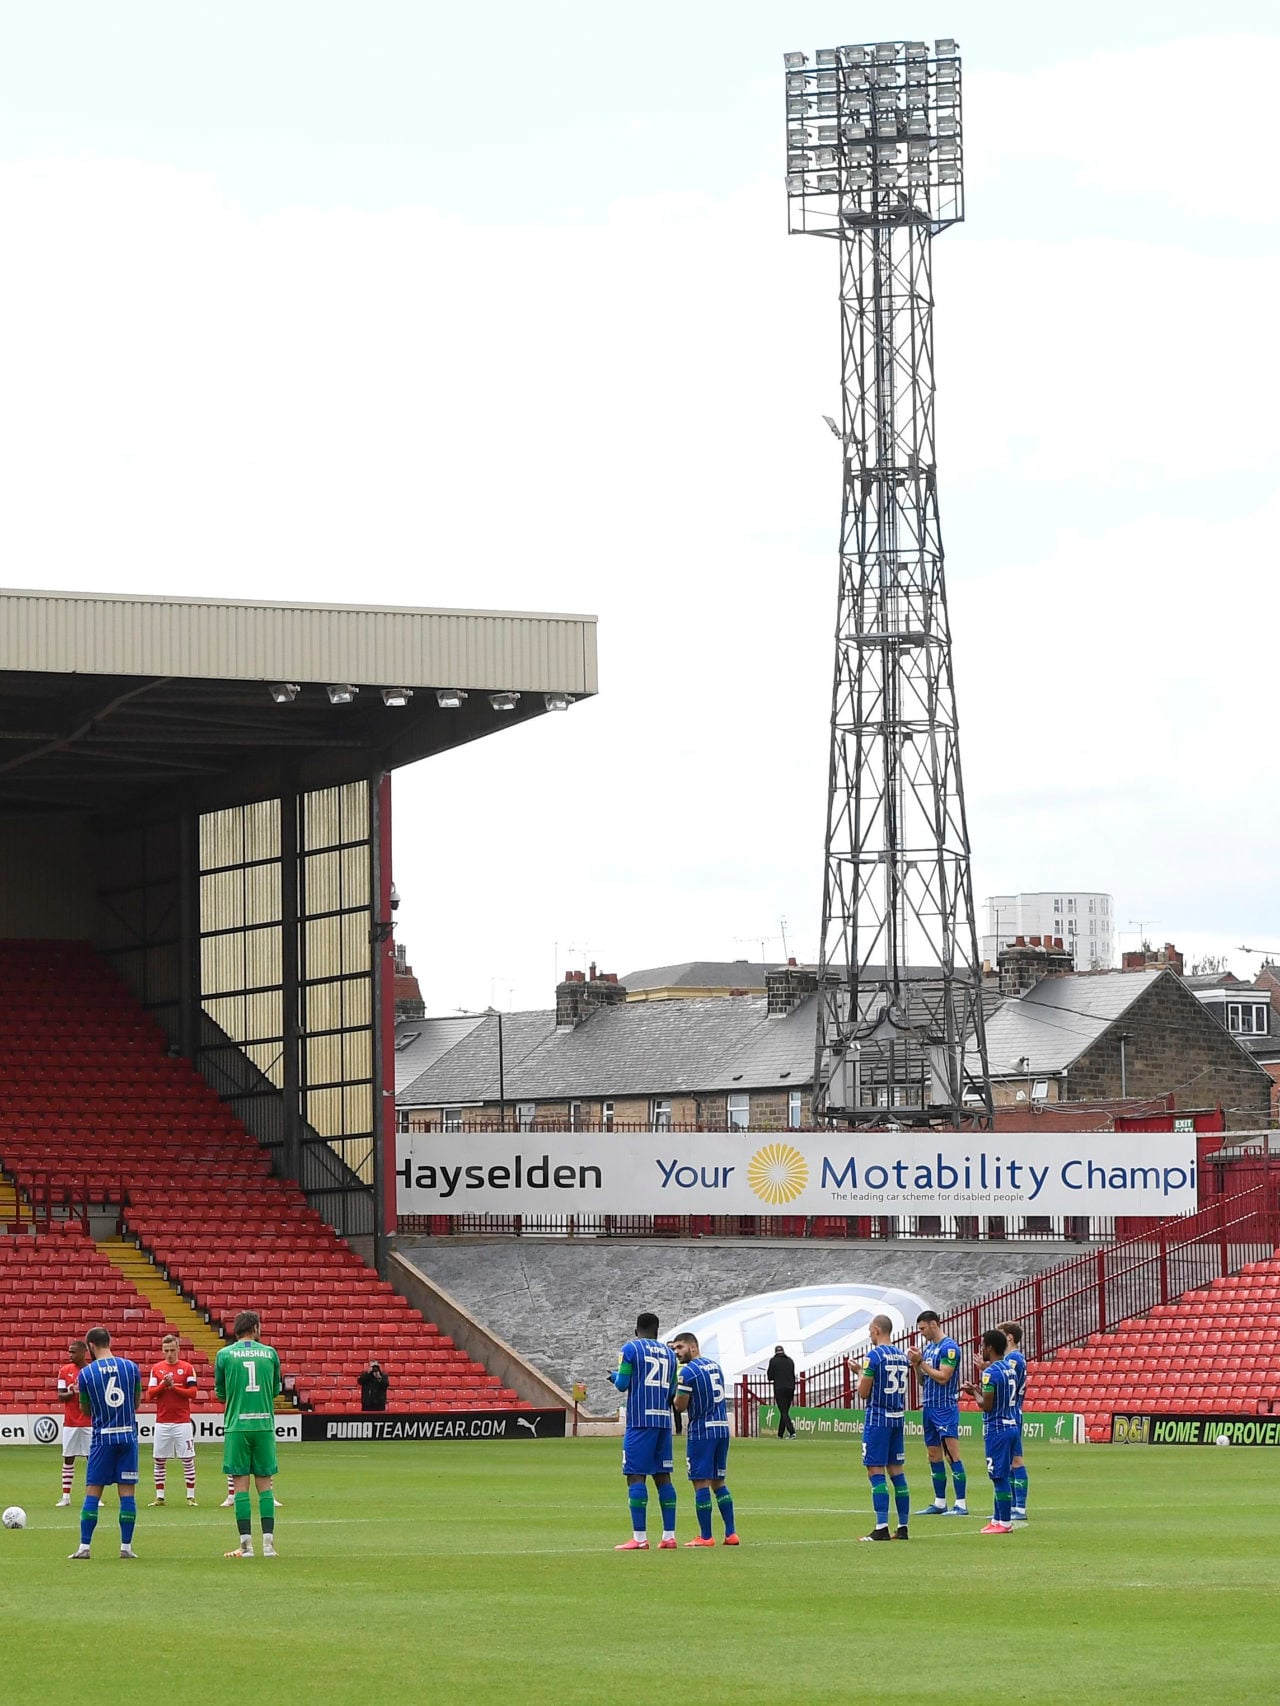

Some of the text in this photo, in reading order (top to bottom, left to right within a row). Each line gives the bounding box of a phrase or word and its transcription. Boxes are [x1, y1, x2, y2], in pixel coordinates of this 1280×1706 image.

[1175, 1119, 1193, 1128] EXIT
[656, 1159, 735, 1188] Your
[821, 1153, 1196, 1200] Motability Champi
[831, 1192, 1025, 1203] The leading car scheme for disabled people
[233, 1350, 273, 1358] MARSHALL
[243, 1361, 260, 1392] 1
[644, 1356, 670, 1388] 21
[884, 1365, 908, 1394] 33
[105, 1376, 125, 1407] 6
[710, 1373, 725, 1403] 5
[1008, 1379, 1017, 1407] 2
[327, 1420, 507, 1438] PUMATEAMWEAR.COM
[818, 1418, 832, 1431] Inn
[834, 1418, 864, 1433] Barnsle
[1114, 1416, 1150, 1444] D&I
[1153, 1421, 1201, 1443] HOME
